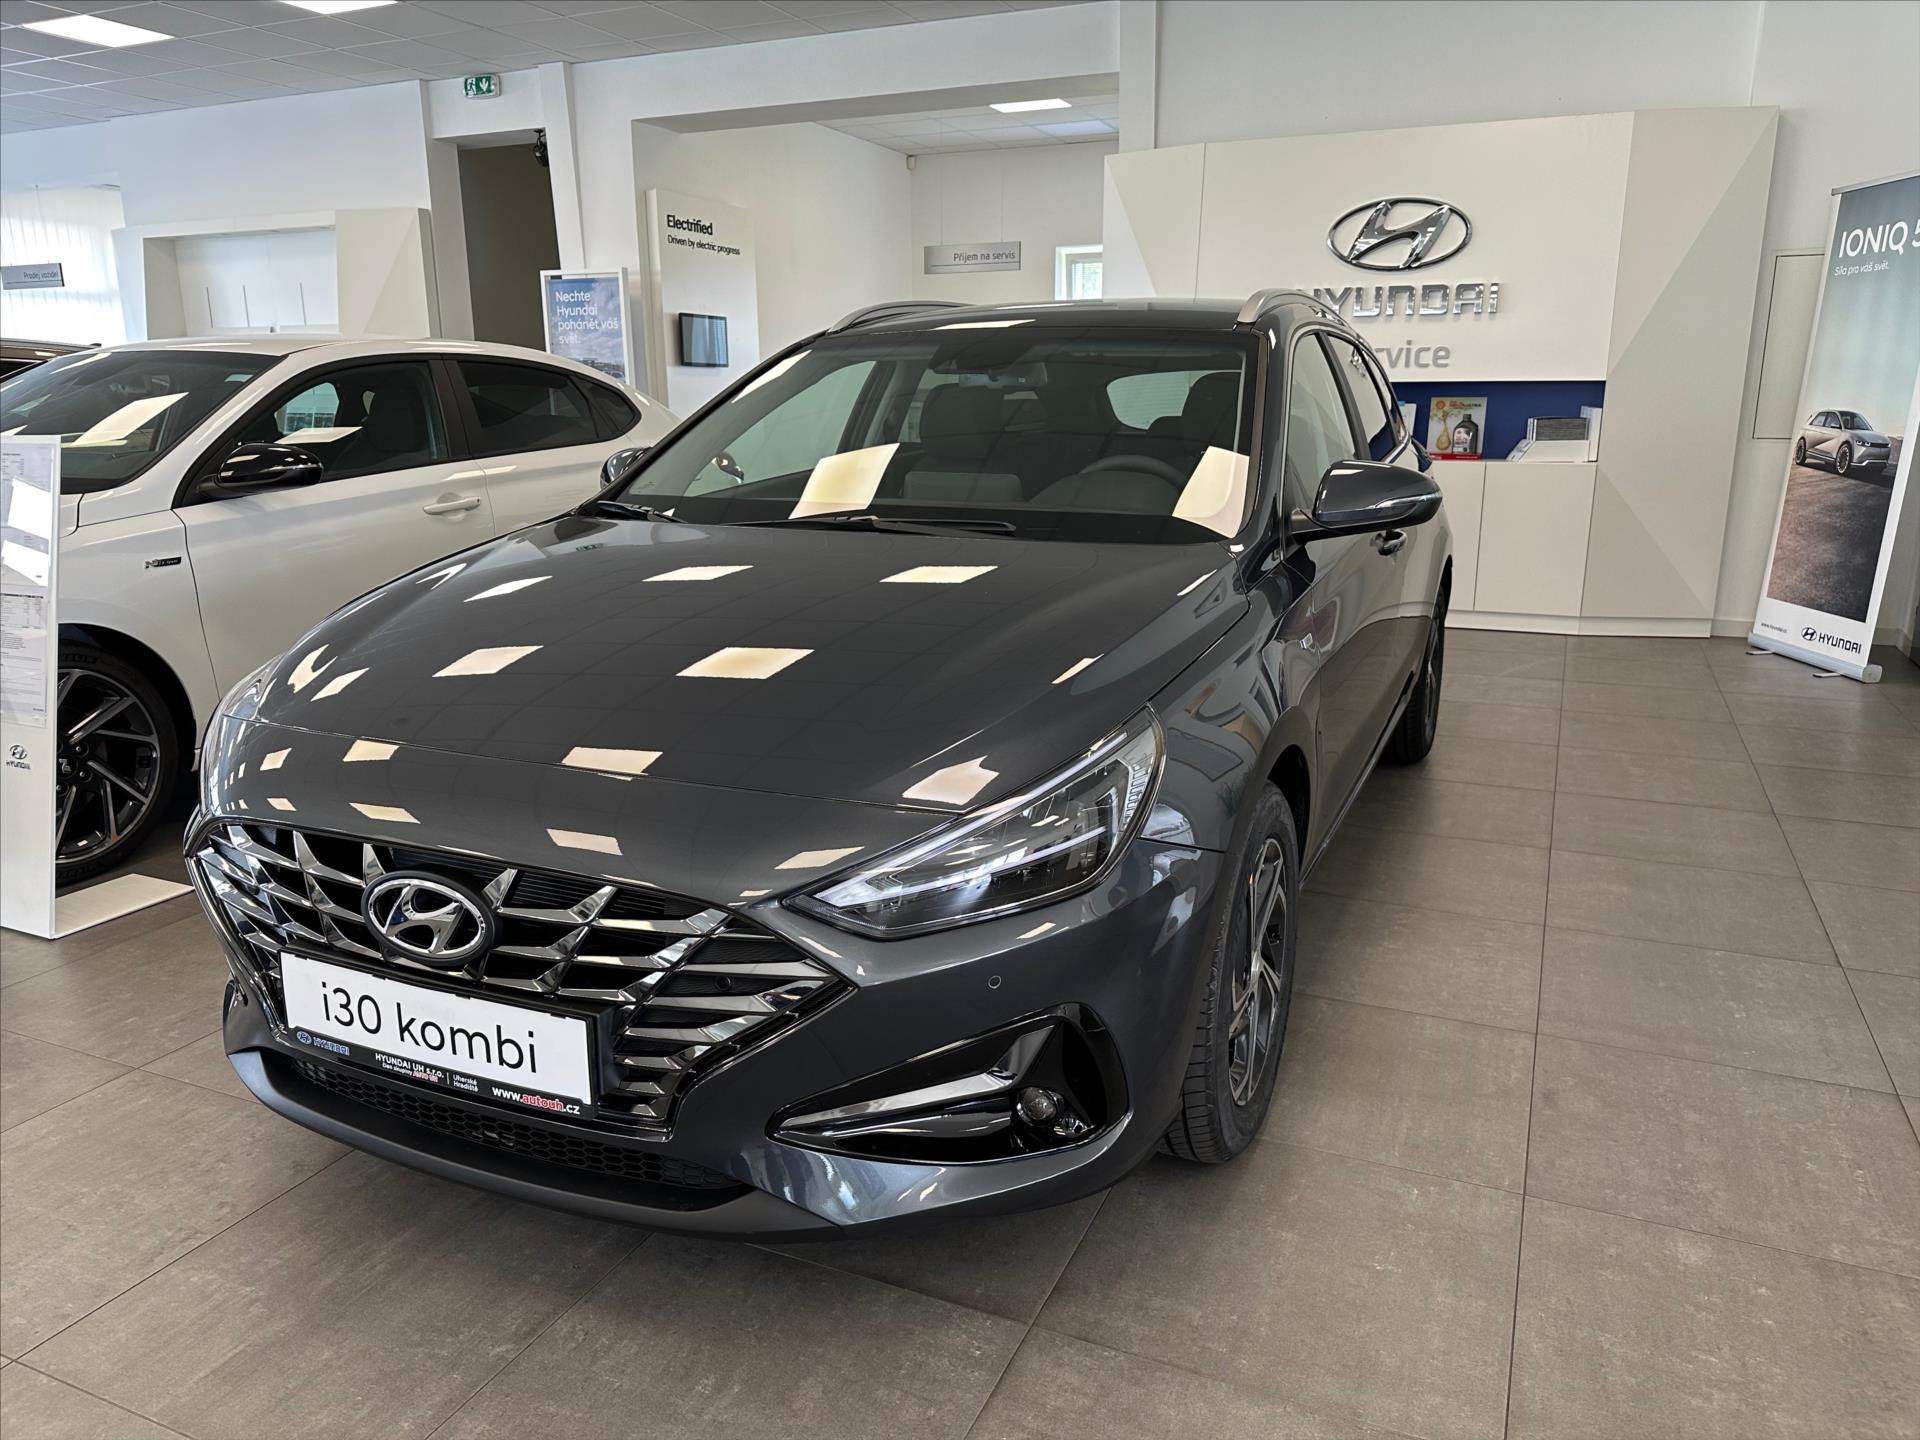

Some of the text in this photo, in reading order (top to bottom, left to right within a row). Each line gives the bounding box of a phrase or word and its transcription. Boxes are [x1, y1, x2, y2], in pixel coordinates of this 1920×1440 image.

[667, 214, 713, 235] Electrified
[668, 235, 741, 255] Driven by electric progress
[1839, 221, 1908, 258] IONIQ
[980, 252, 991, 261] na
[992, 250, 1016, 261] servis
[555, 290, 591, 302] Nechte
[556, 304, 598, 318] Hyundai
[558, 317, 619, 333] pohánět váš
[1374, 340, 1451, 368] vice
[1819, 632, 1862, 655] HYUNDAI
[321, 981, 537, 1074] i30 kombi
[375, 1052, 444, 1078] HYUNDAI UH s.r.o.
[452, 1073, 478, 1085] Uherské
[453, 1079, 479, 1092] Hradiště
[492, 1086, 581, 1115] www.autouh.cz
